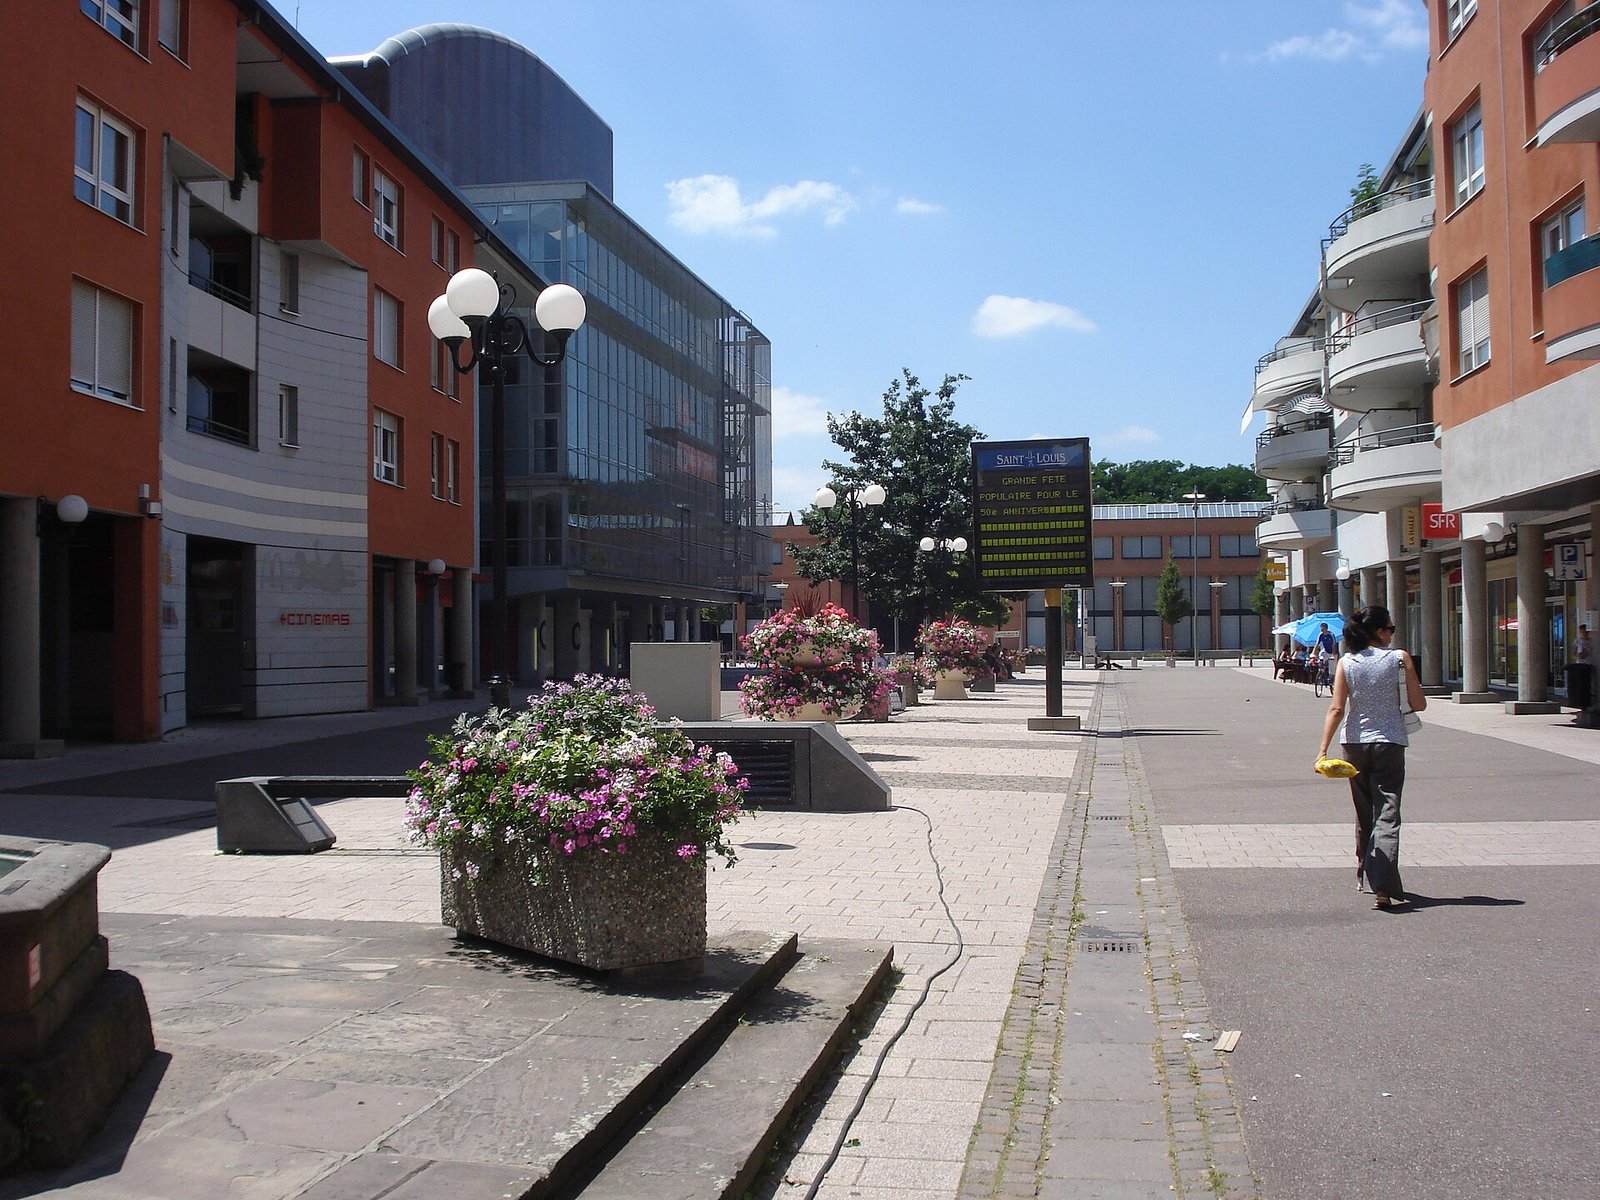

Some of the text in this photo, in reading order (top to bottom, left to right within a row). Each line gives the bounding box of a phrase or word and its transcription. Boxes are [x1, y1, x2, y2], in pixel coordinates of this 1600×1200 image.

[1002, 475, 1066, 486] GRANDE FETE
[979, 489, 1079, 501] POPULAIRE POUR LE
[1429, 513, 1456, 529] SFR
[1563, 546, 1575, 560] P
[287, 613, 350, 626] CINEMAS
